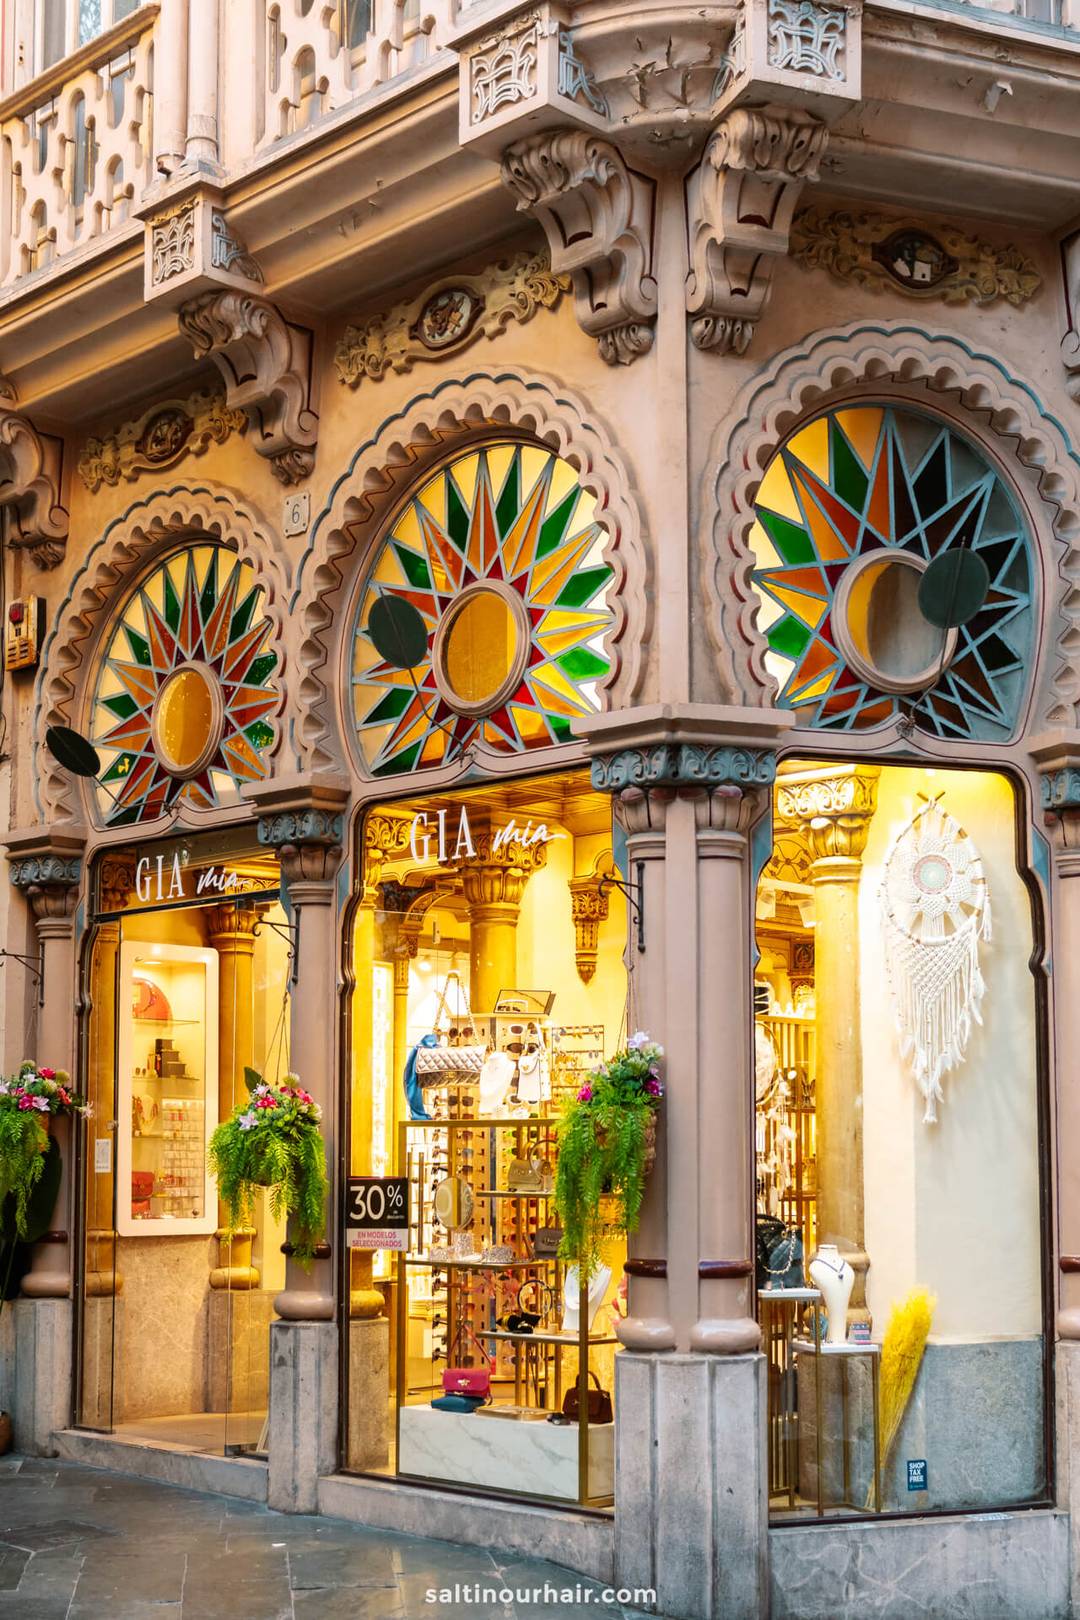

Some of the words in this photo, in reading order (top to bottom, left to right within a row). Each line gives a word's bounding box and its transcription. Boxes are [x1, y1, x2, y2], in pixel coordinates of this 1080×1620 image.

[292, 503, 300, 524] 6
[410, 804, 477, 864] GIA
[492, 818, 568, 852] mia
[135, 852, 186, 902] GIA
[196, 865, 253, 895] mia
[350, 1185, 403, 1220] 30%
